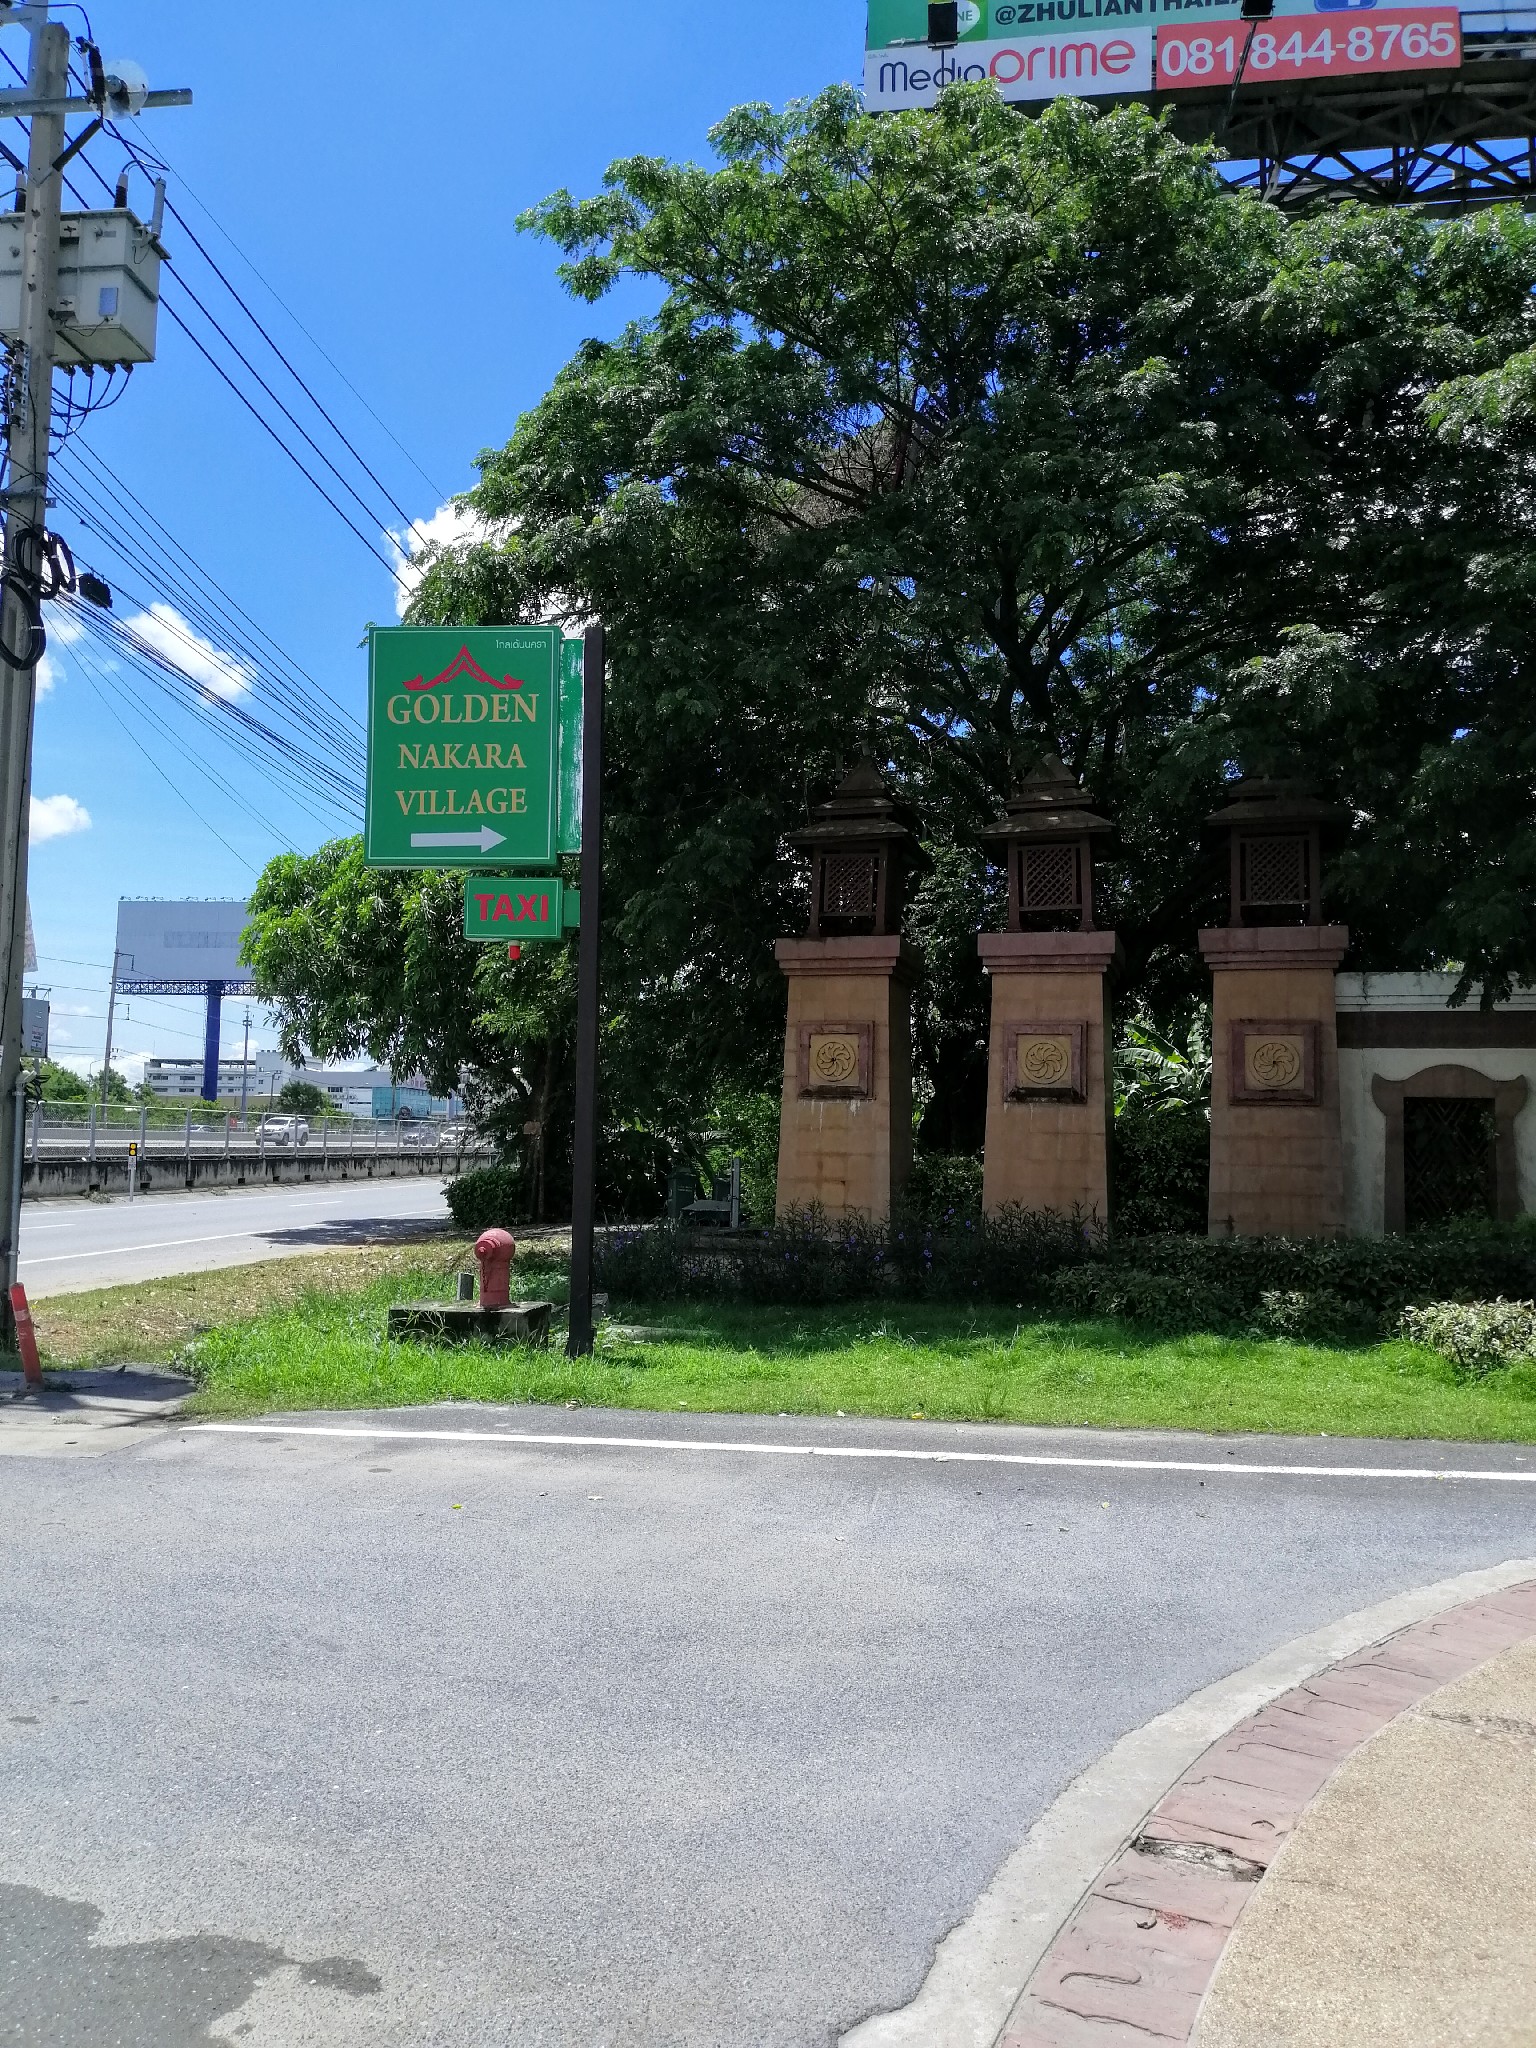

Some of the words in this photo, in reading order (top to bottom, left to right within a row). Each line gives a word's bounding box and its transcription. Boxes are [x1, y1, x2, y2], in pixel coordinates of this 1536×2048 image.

[1161, 22, 1456, 77] 081844-8765
[387, 693, 539, 725] GOLDEN
[397, 743, 527, 769] NAKARA
[395, 788, 528, 816] VILLAGE
[473, 893, 549, 922] TAXI
